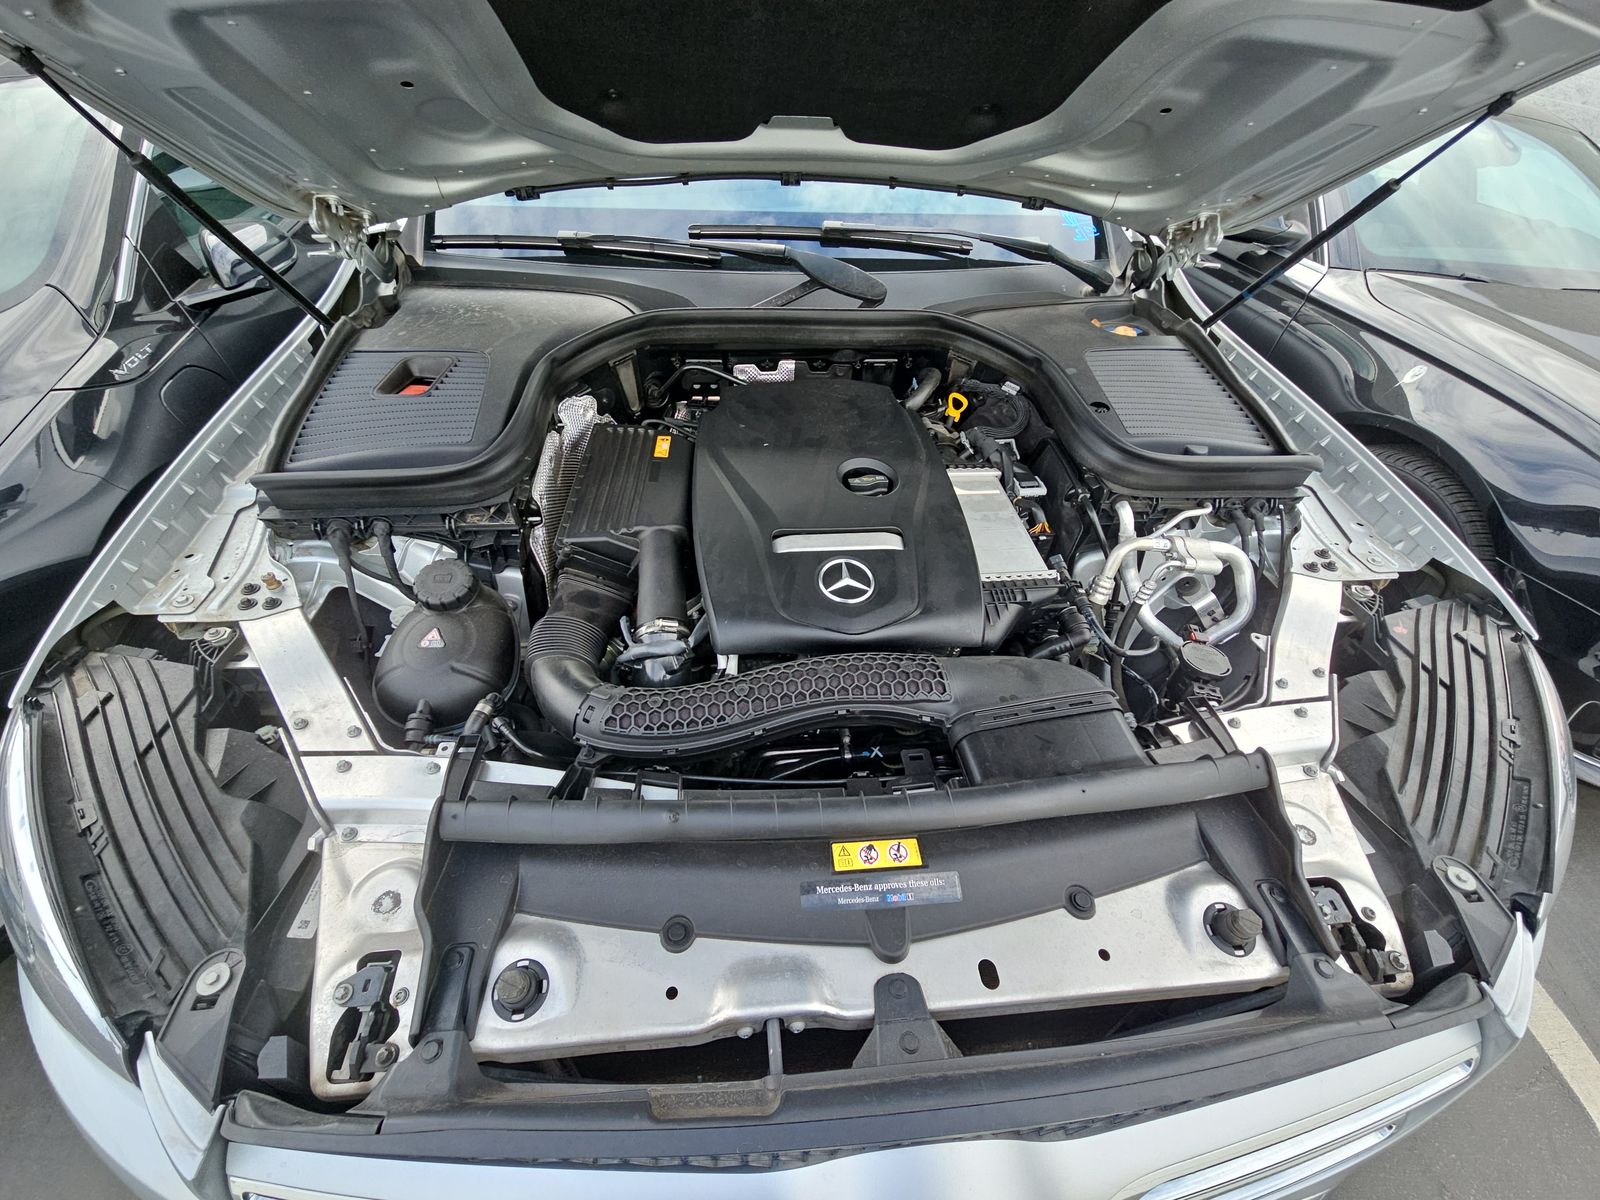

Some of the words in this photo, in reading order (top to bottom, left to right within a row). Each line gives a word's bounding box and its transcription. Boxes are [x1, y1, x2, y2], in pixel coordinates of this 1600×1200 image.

[109, 343, 152, 376] VOLT
[816, 883, 873, 894] Mercedes-Benz
[873, 881, 907, 892] approves
[908, 879, 929, 888] these
[930, 877, 945, 887] oils:
[837, 895, 880, 905] Mercedes-Benz
